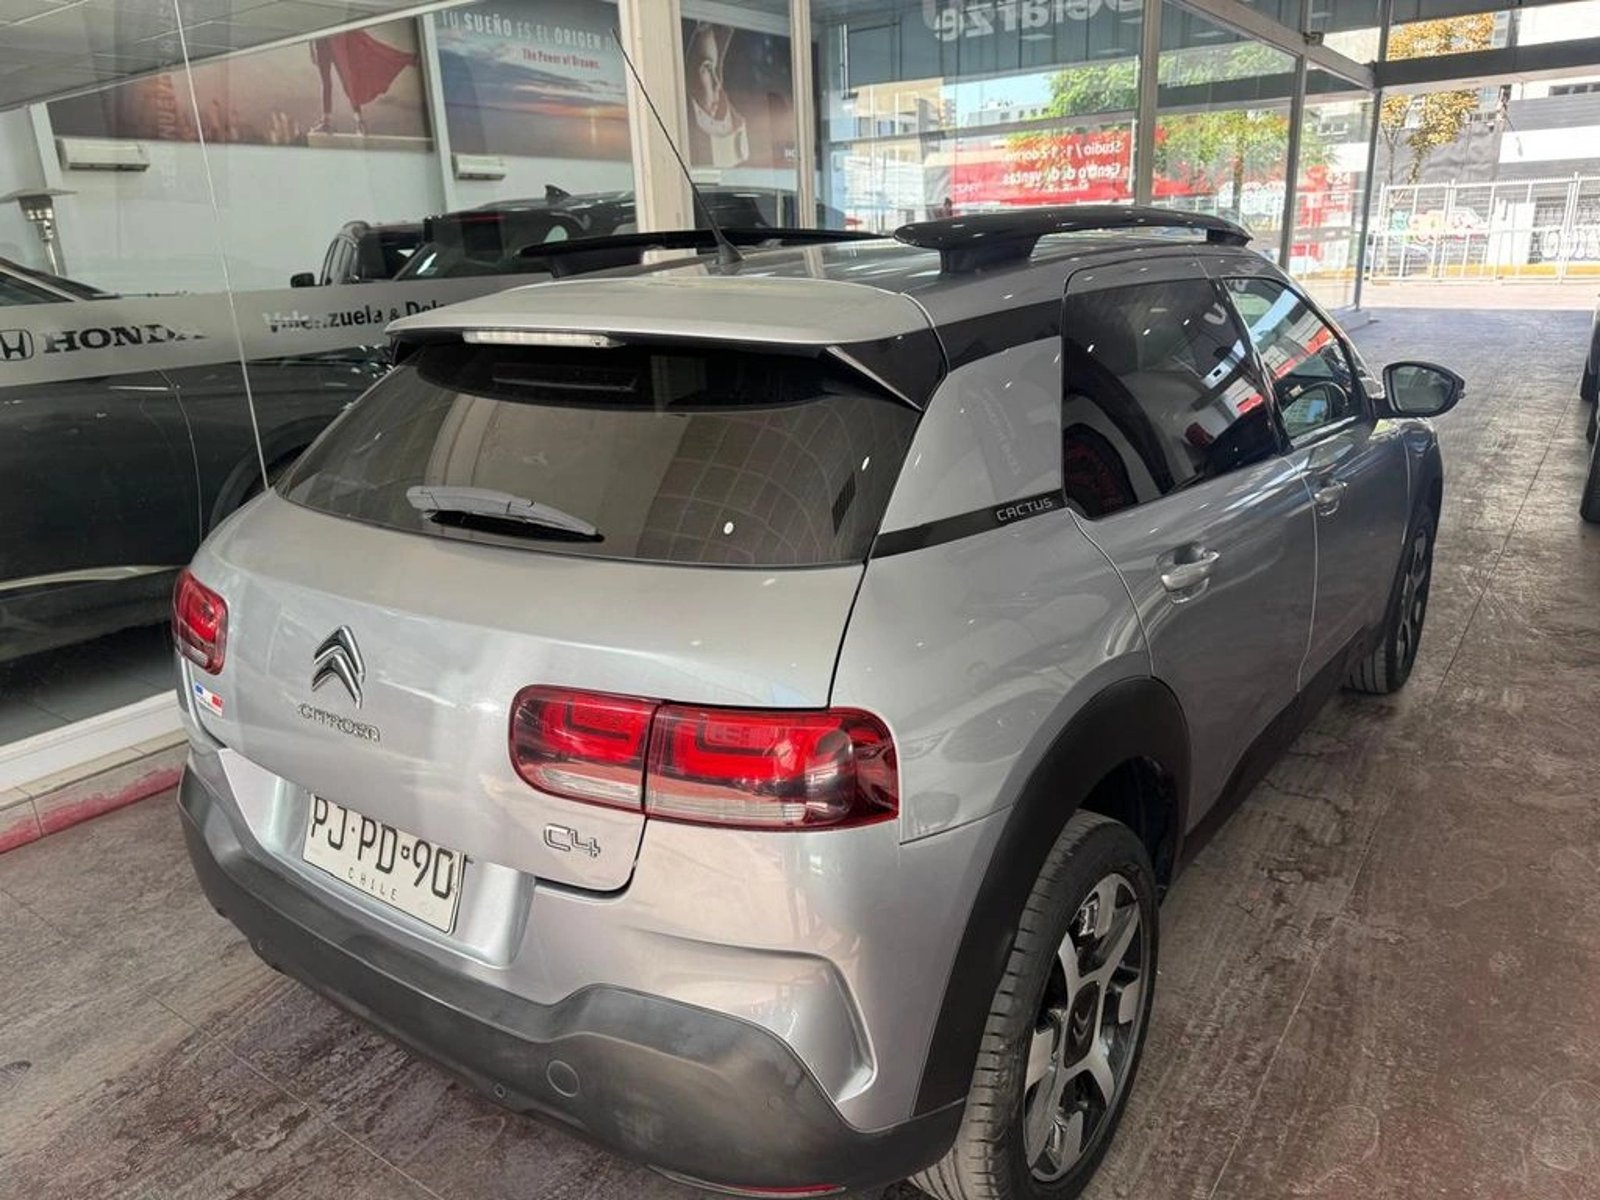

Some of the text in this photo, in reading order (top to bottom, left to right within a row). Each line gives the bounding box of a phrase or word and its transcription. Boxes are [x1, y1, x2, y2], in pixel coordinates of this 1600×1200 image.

[441, 10, 459, 29] TU
[463, 11, 512, 37] SUEÑO
[554, 26, 602, 50] ORIGEN
[996, 497, 1053, 521] CACTUS
[543, 822, 601, 858] C4
[349, 867, 399, 901] CHILE
